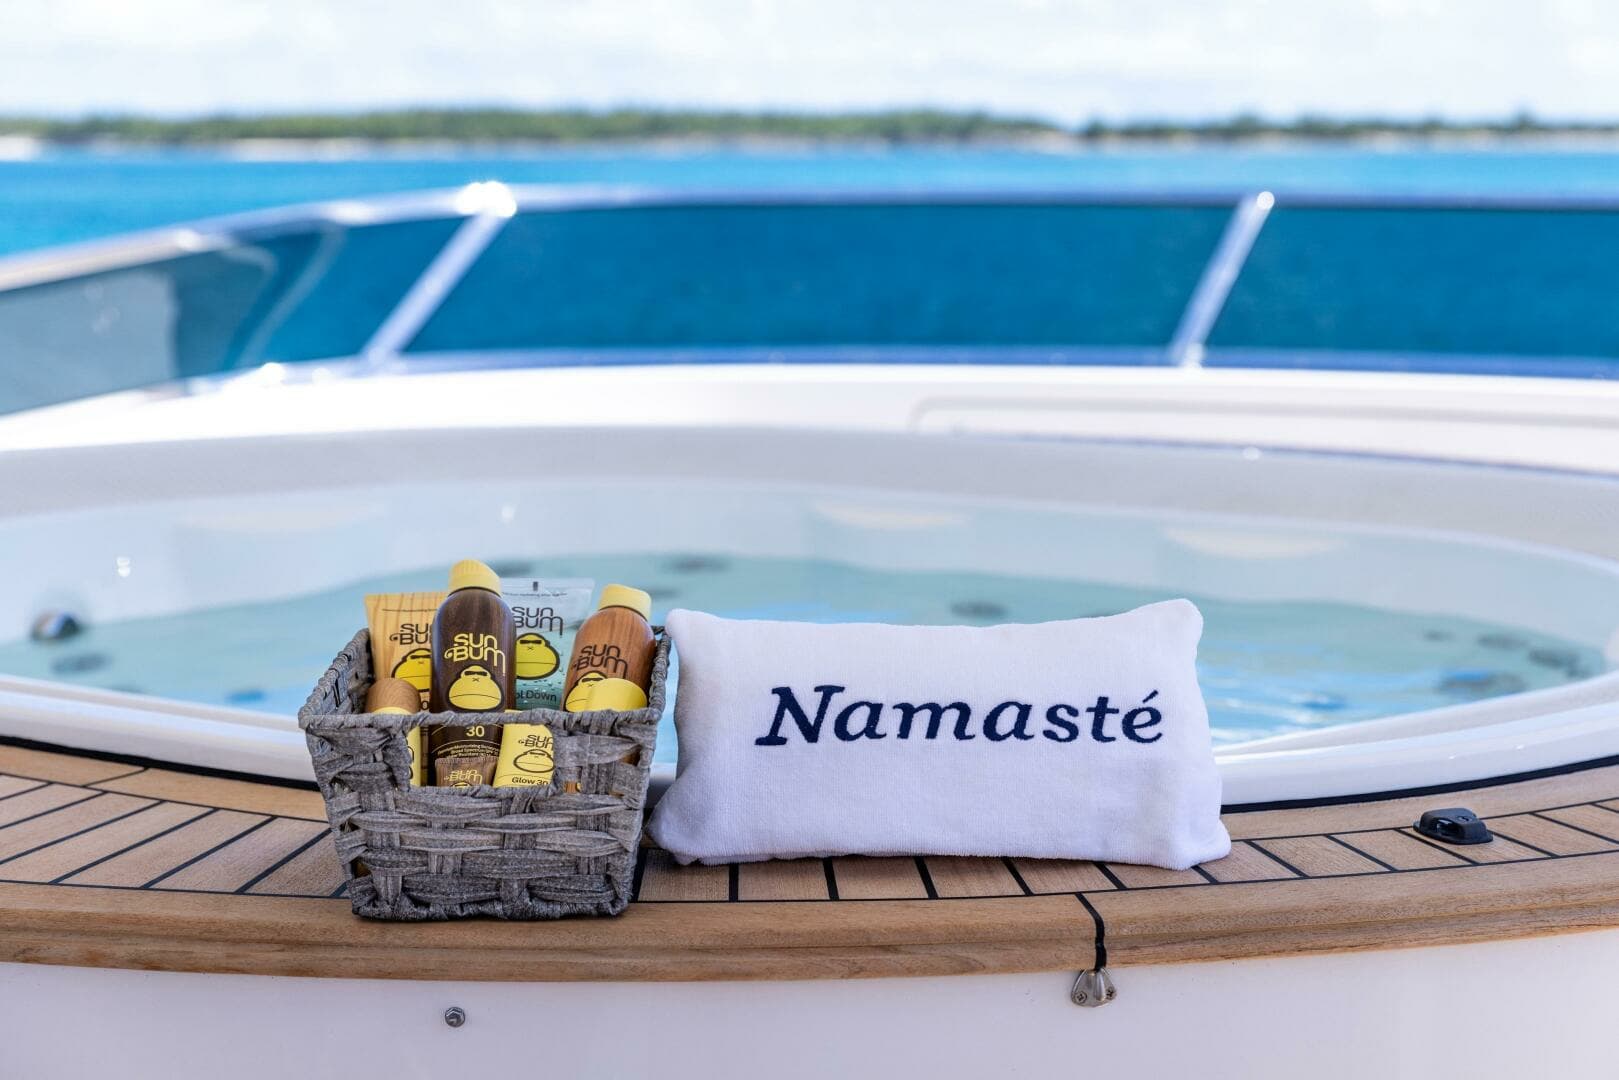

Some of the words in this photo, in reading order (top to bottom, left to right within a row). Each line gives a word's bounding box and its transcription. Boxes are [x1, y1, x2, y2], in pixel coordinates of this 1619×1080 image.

[400, 623, 432, 633] SU
[389, 632, 432, 645] BU
[526, 690, 557, 702] Down
[754, 684, 1163, 746] Namasté
[465, 725, 485, 738] 30
[511, 776, 535, 785] Glow
